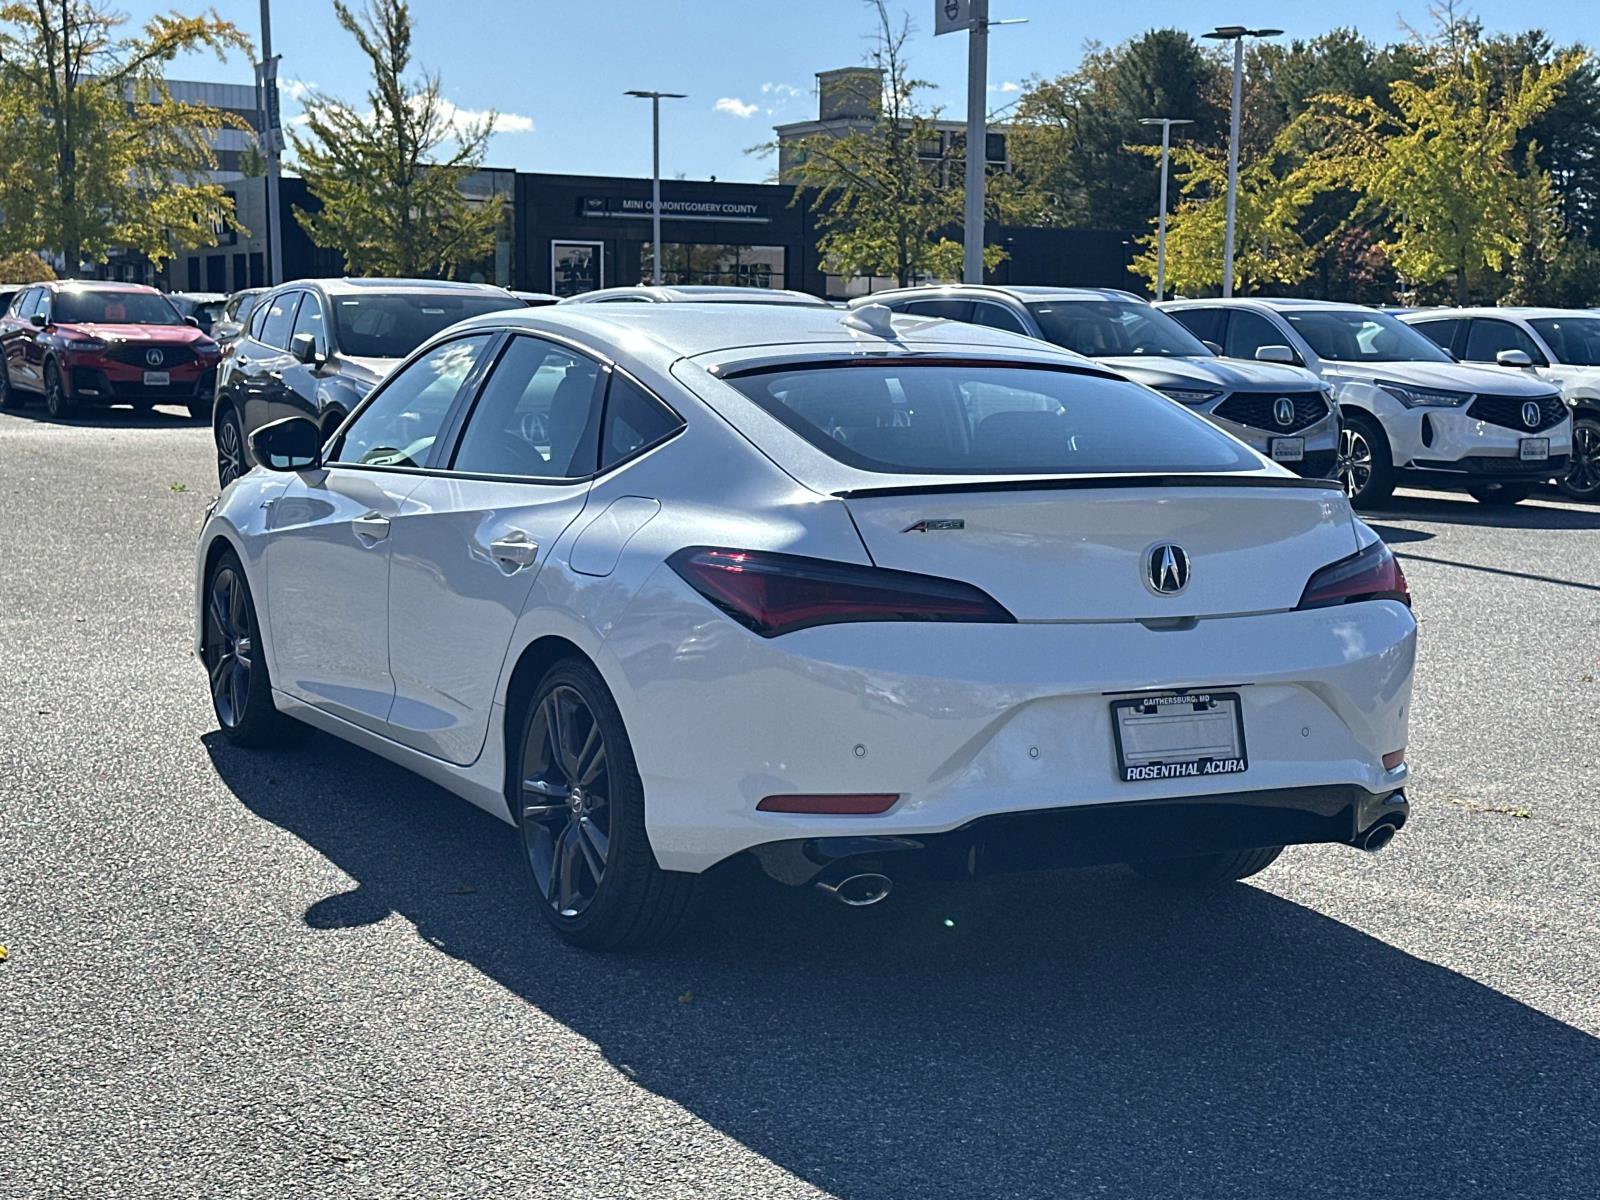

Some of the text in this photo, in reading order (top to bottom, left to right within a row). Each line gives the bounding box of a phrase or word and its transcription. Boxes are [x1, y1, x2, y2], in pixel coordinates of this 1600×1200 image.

[622, 199, 758, 214] MINI O MONTGOMERY COUNTY
[1127, 759, 1245, 780] ROSENTHAL ACURA
